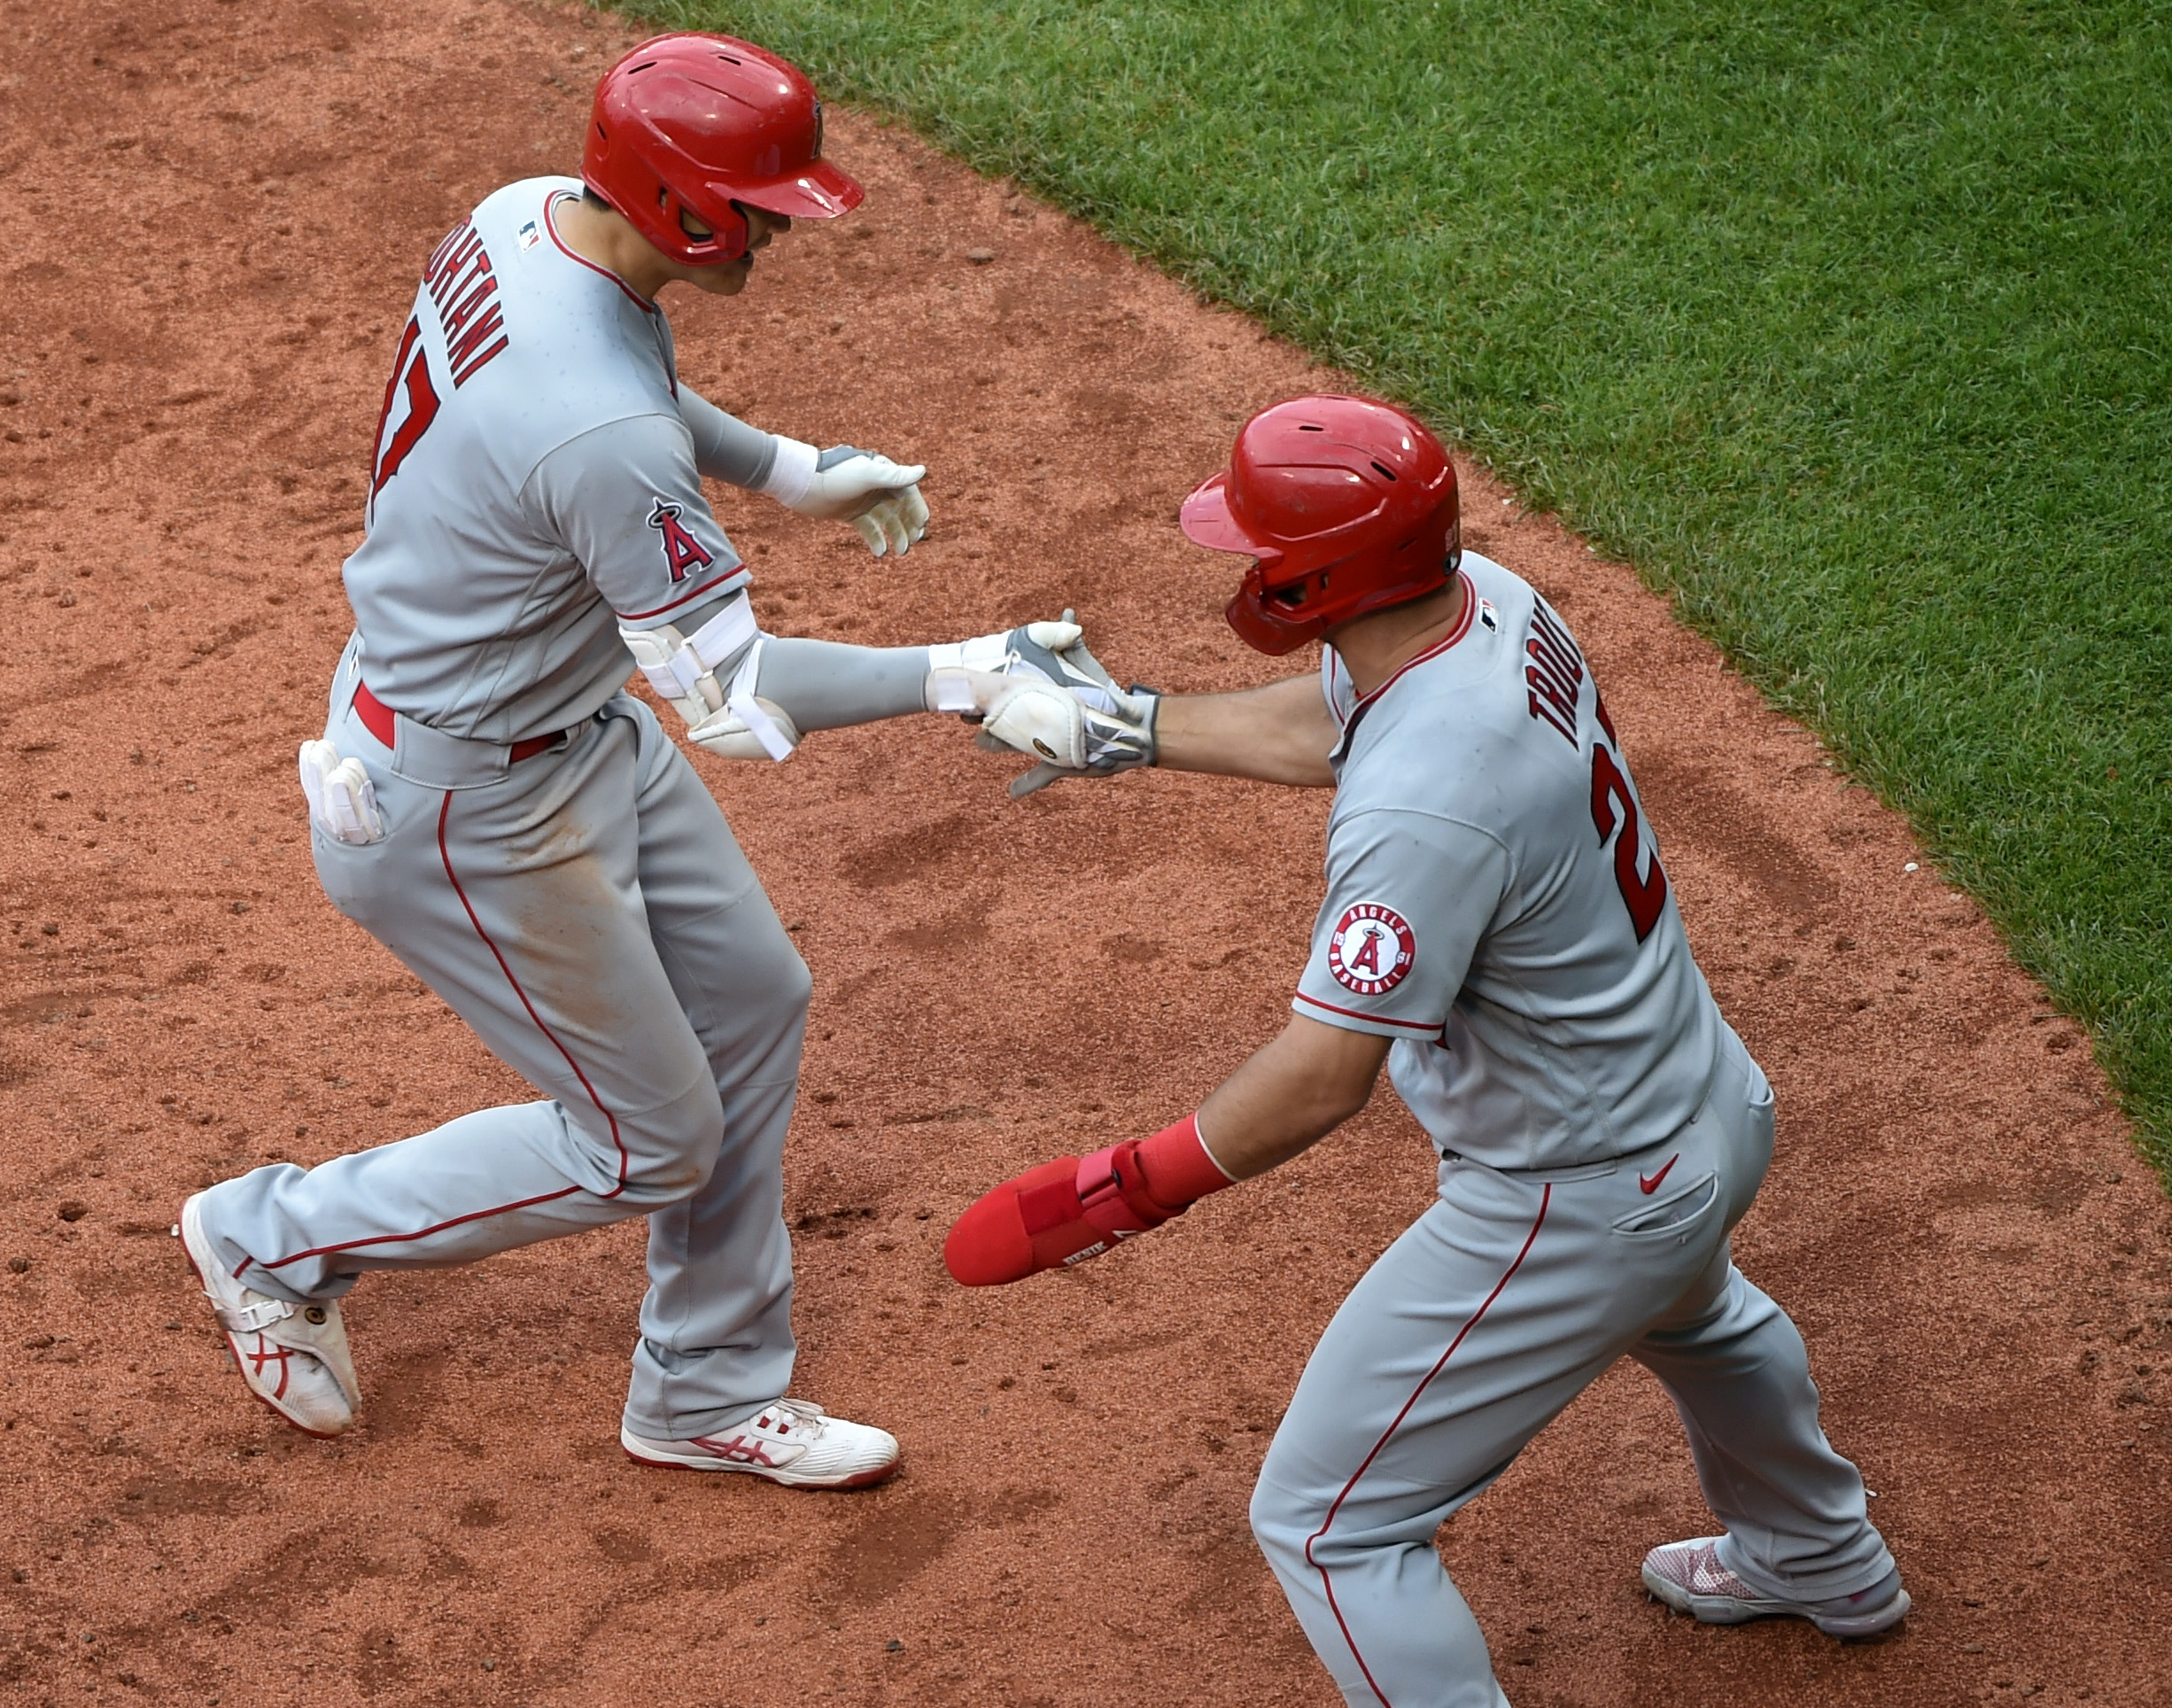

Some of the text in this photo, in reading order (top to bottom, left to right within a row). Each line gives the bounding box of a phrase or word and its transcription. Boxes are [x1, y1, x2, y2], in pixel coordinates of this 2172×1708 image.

[423, 214, 509, 391] OHTANI
[370, 314, 441, 524] 17
[647, 497, 715, 584] A
[1592, 689, 1666, 944] 2
[1349, 905, 1408, 935] ANGELS
[1350, 922, 1385, 975] A
[1330, 952, 1403, 994] BASEBALL
